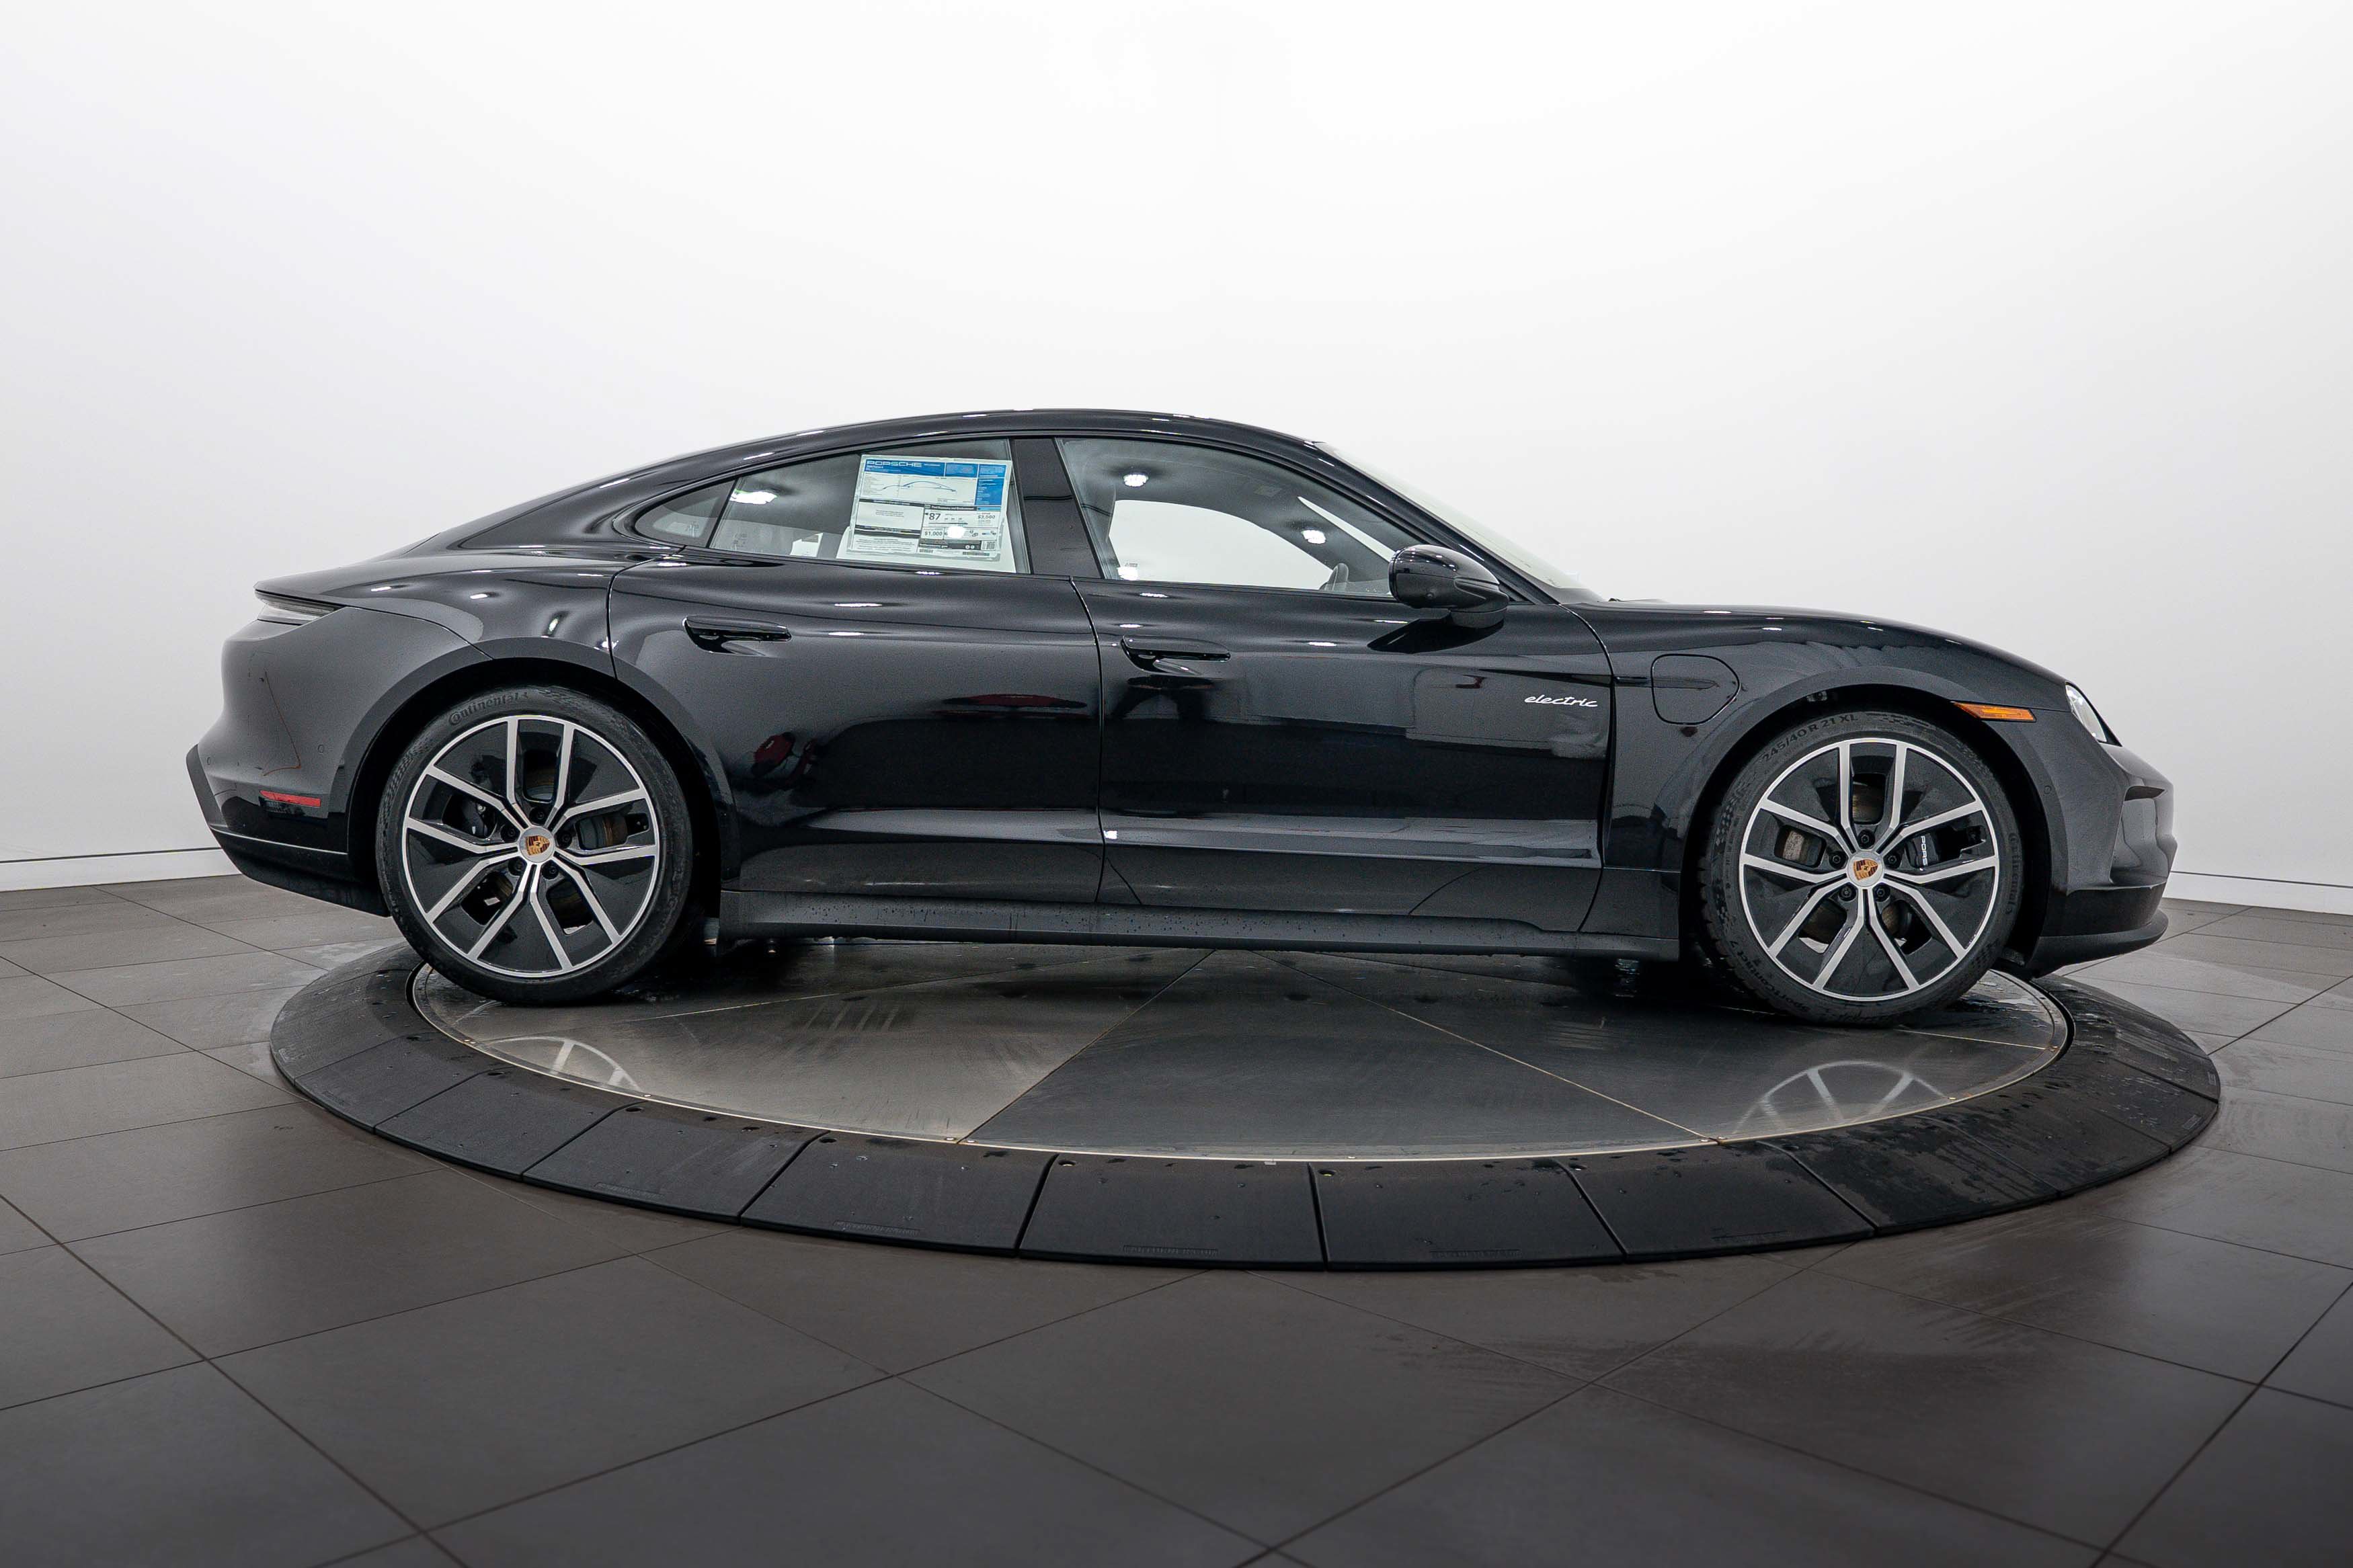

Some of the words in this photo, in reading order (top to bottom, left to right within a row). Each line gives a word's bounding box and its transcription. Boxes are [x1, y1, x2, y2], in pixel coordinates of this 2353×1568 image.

[448, 692, 518, 725] Continental
[1525, 694, 1598, 707] electric
[1763, 728, 1806, 761] 245/40
[1807, 724, 1820, 733] R
[1821, 717, 1837, 728] 21
[1839, 713, 1859, 723] XL
[1920, 835, 1928, 867] PORS
